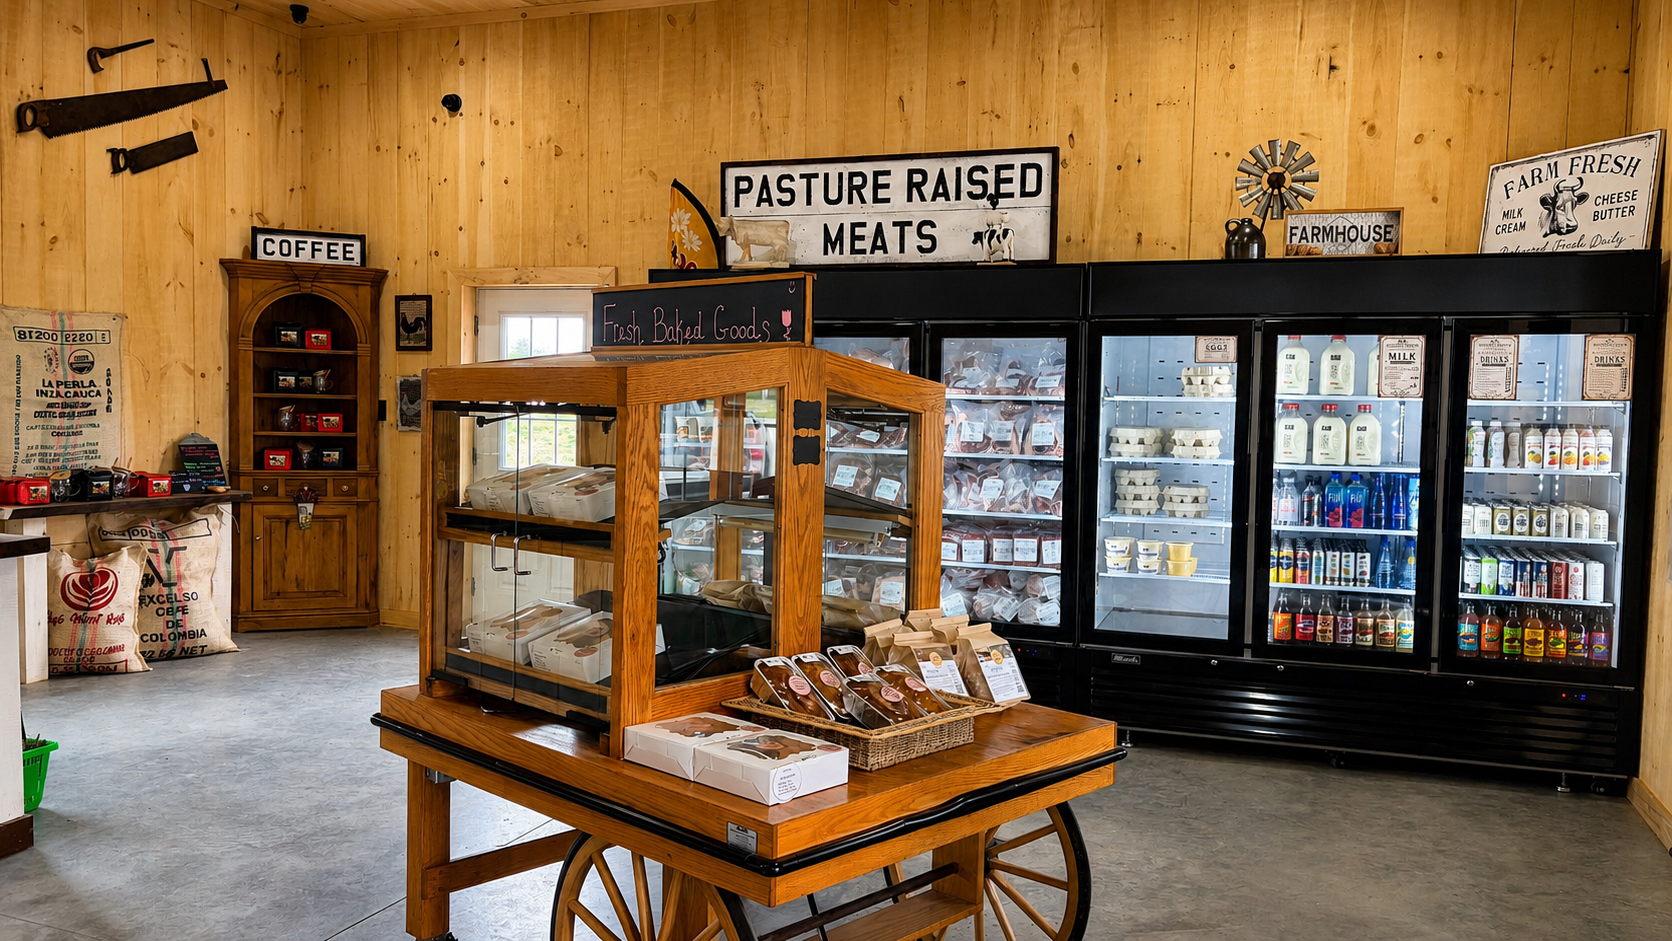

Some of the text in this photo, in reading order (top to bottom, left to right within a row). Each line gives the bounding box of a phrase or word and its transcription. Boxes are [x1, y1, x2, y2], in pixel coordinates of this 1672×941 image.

[1503, 153, 1641, 199] FARM FRESH
[734, 162, 1043, 208] PASTURE RAISED
[1594, 189, 1639, 206] CHEESE
[1502, 207, 1523, 221] MILK
[1592, 205, 1635, 221] BUTTER
[1289, 224, 1394, 243] FARMHOUSE
[1495, 221, 1526, 235] CREAM
[822, 219, 937, 256] MEATS
[1589, 231, 1626, 249] Daily
[263, 238, 355, 261] COFFEE
[603, 303, 770, 345] Fresh Baked Goods
[1388, 352, 1416, 360] MILK
[1480, 355, 1509, 363] DRINKS
[1594, 355, 1626, 363] DRINKS
[42, 378, 97, 389] LA PERLA
[64, 389, 102, 398] CAUCA
[138, 592, 198, 605] EXCELSO
[166, 619, 183, 629] DE
[140, 628, 207, 643] COLOMBIA
[179, 645, 208, 656] NET
